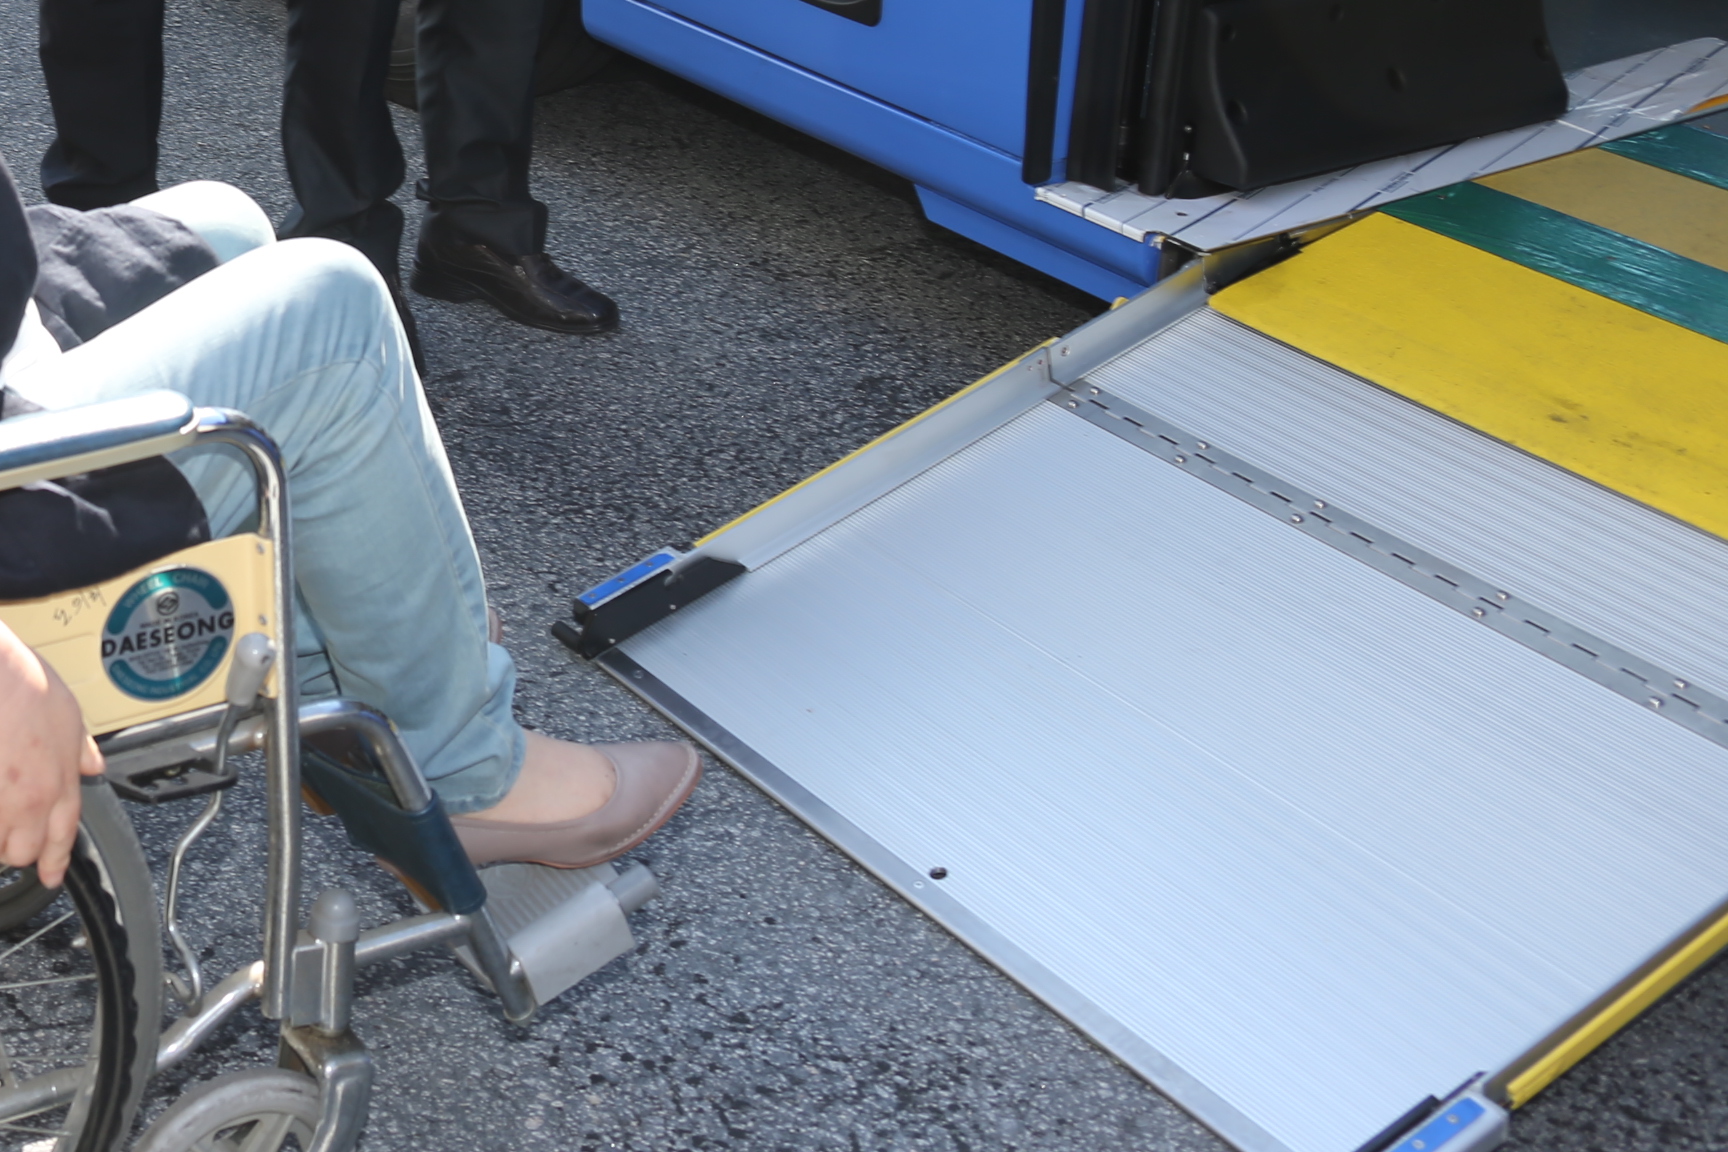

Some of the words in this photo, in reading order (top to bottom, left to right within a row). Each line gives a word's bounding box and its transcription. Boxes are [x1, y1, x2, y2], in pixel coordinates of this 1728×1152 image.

[121, 575, 162, 609] WHEEL
[172, 572, 210, 589] CHAIR
[101, 611, 235, 658] DAESEONG
